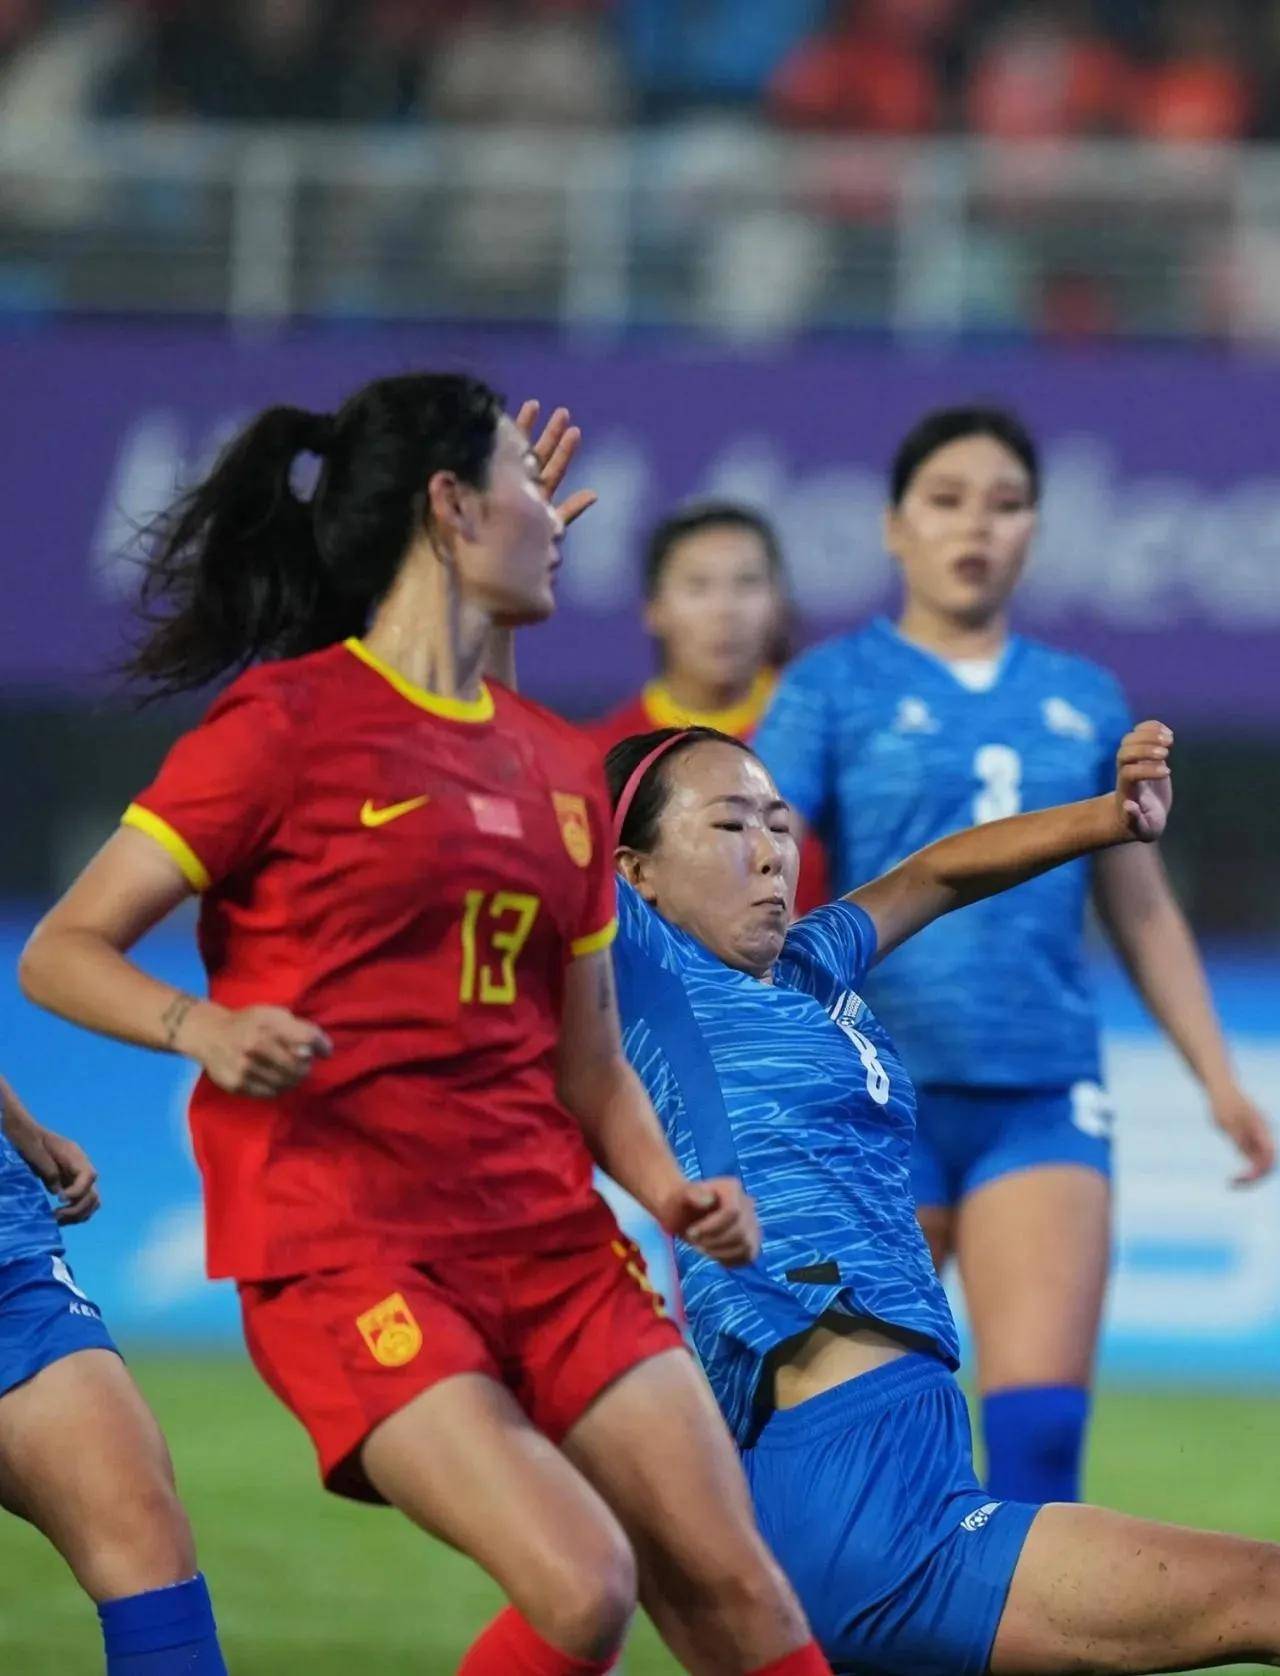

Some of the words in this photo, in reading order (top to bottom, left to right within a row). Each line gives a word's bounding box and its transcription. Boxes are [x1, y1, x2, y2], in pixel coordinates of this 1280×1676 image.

[974, 744, 1022, 827] 3
[460, 890, 540, 1004] 13
[837, 1020, 890, 1105] 8
